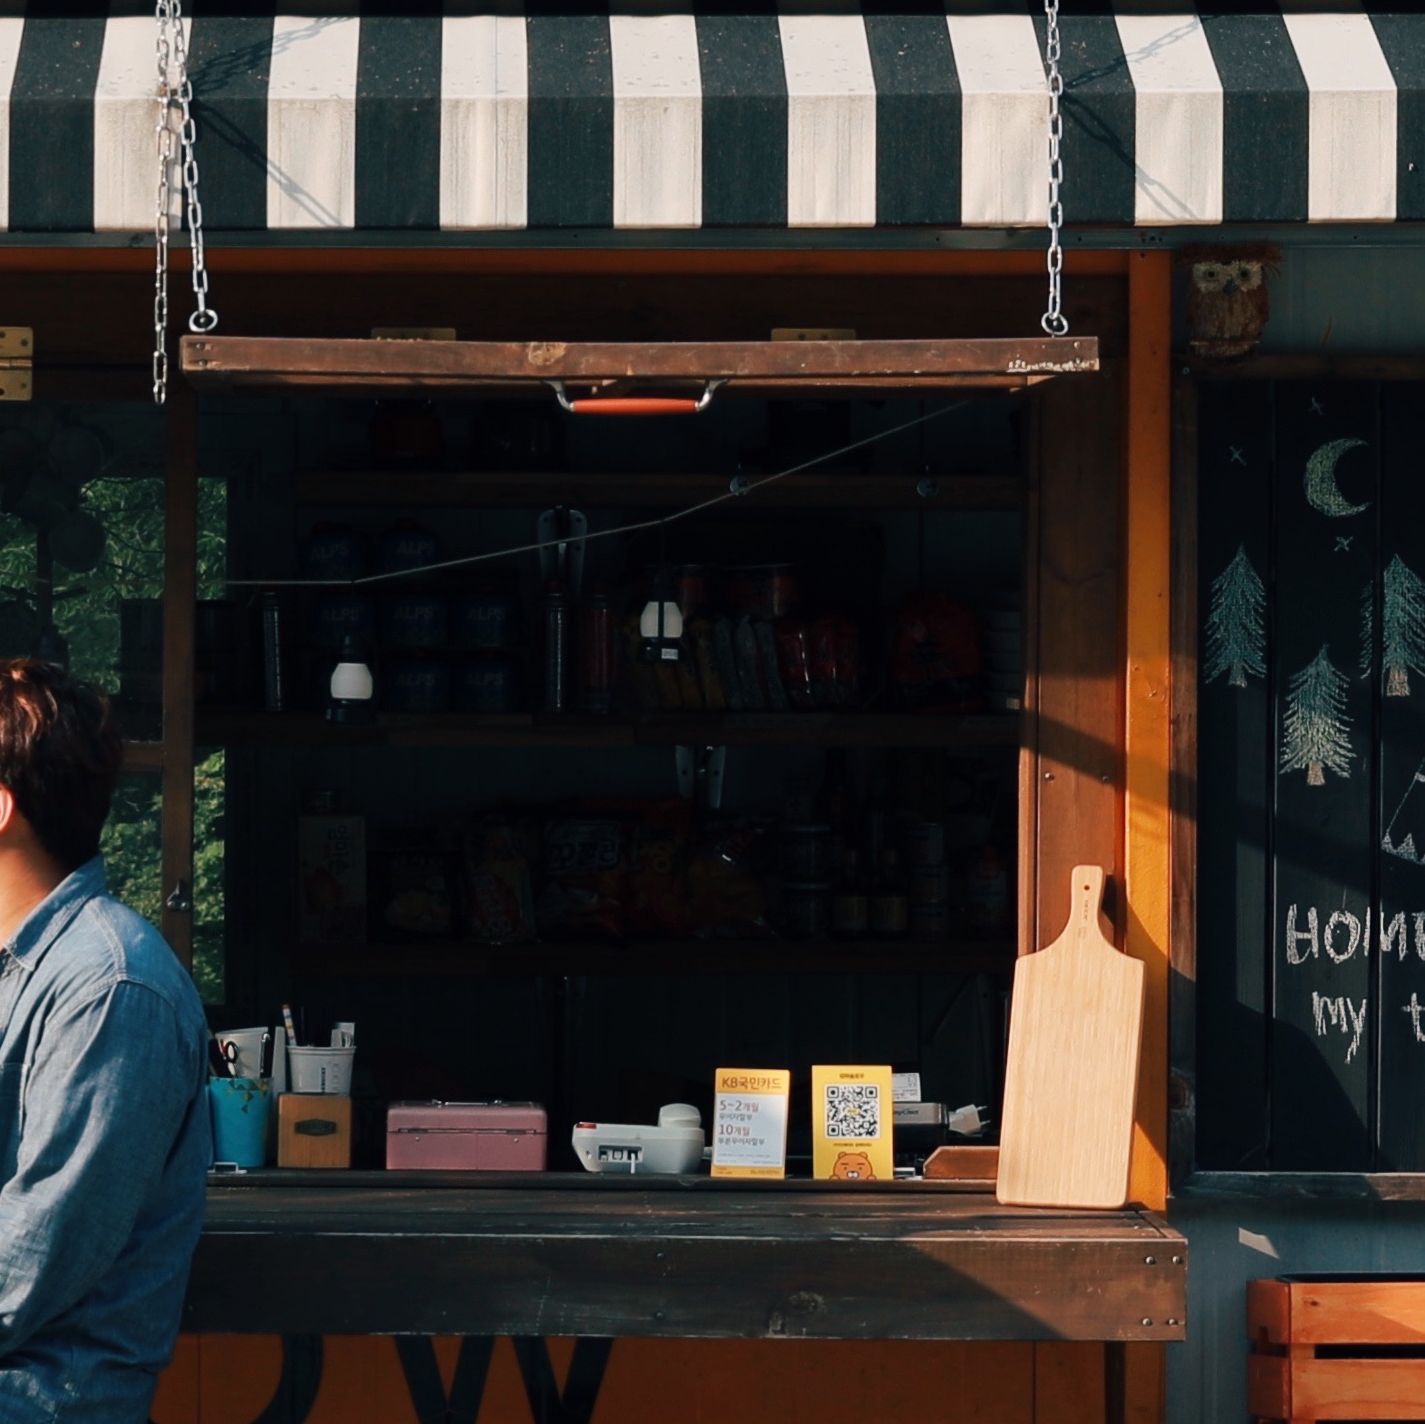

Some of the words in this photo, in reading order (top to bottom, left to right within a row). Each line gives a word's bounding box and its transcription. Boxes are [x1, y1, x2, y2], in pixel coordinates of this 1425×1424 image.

[396, 540, 436, 557] ALPS
[393, 606, 434, 622] ALPS
[465, 606, 506, 622] ALPS
[462, 670, 504, 687] ALPS
[1311, 989, 1368, 1065] my
[721, 1076, 783, 1090] KB국민카드
[718, 1125, 751, 1136] 10개월
